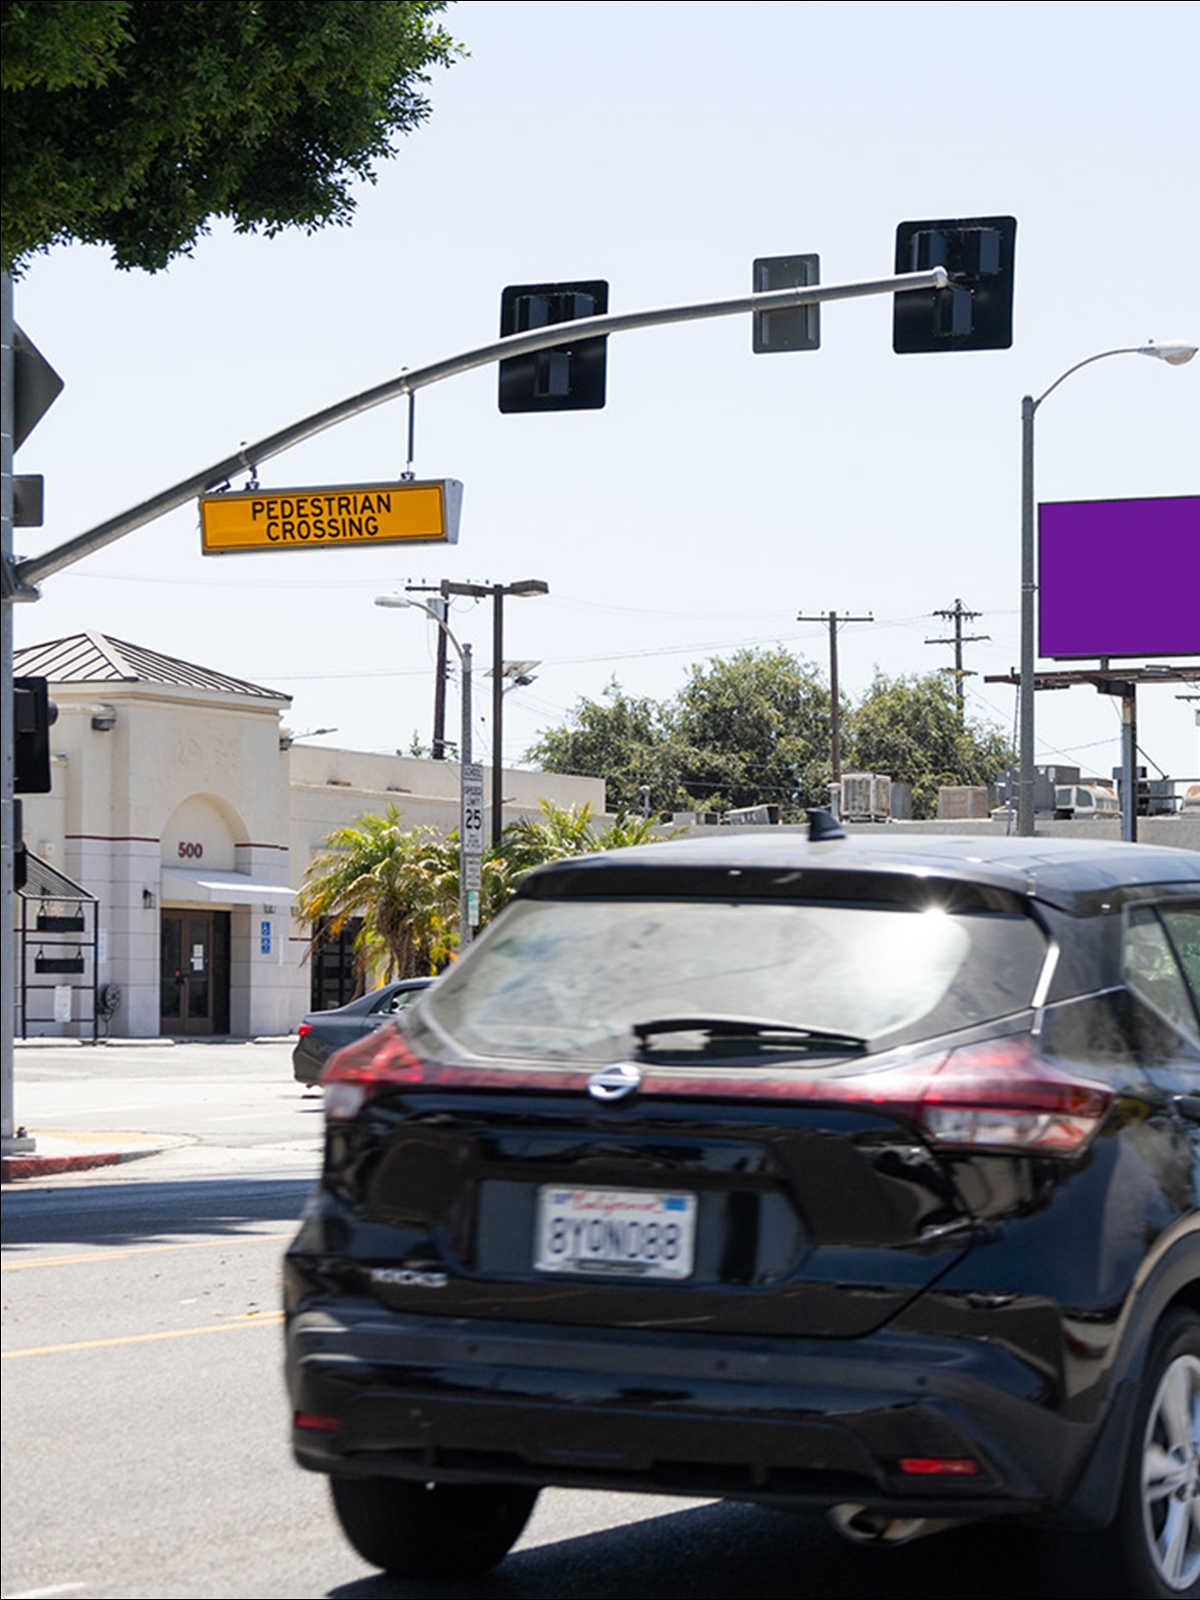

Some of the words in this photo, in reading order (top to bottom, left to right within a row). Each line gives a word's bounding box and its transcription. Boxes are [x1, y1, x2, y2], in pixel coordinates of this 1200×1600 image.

[252, 494, 391, 521] PEDESTRIAN
[266, 516, 379, 541] CROSSING
[465, 808, 482, 830] 25
[178, 842, 203, 859] 500
